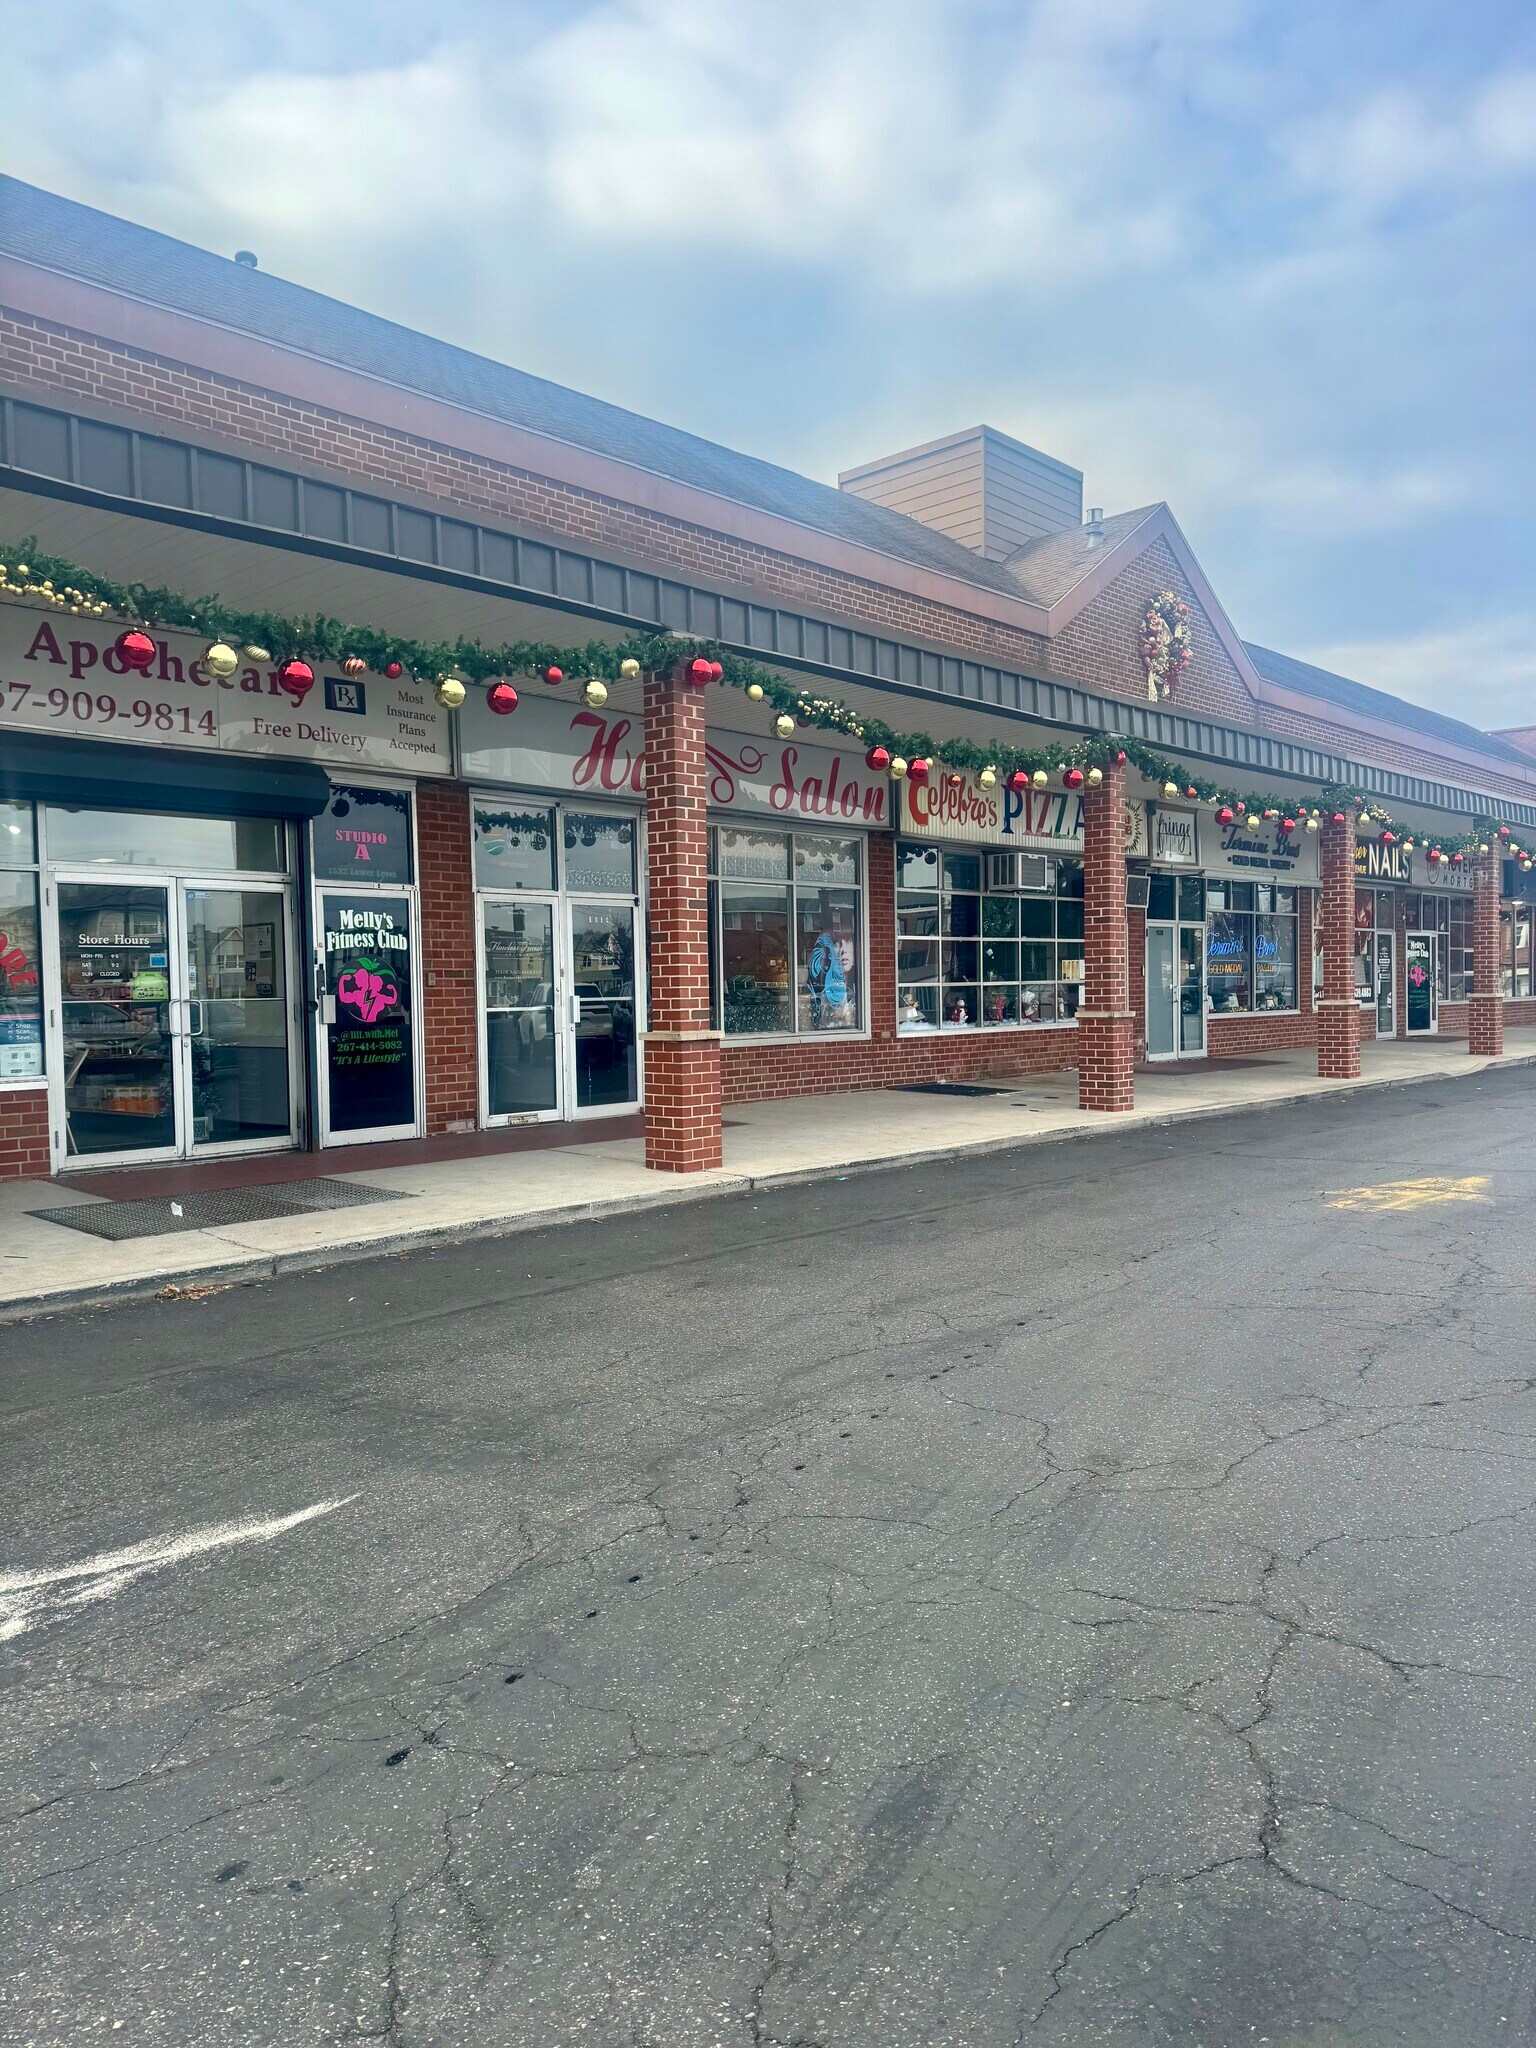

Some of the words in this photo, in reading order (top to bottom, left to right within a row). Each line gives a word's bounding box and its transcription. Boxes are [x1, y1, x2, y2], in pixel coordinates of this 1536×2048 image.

[398, 690, 424, 705] Most
[0, 680, 217, 737] 7-909-9814
[386, 705, 437, 723] Insurance
[253, 717, 292, 738] Free
[297, 723, 366, 752] Delivery
[398, 723, 426, 737] Plans
[389, 738, 436, 754] Accepted
[769, 746, 887, 822] Salon
[335, 829, 387, 845] STUDIO
[1156, 812, 1191, 854] fringe
[1221, 823, 1269, 854] Termini
[354, 843, 371, 860] A
[1368, 843, 1410, 879] NAILS
[1443, 876, 1474, 888] MORTG
[339, 909, 394, 930] Melly's
[79, 934, 110, 945] Store
[114, 934, 150, 945] Hours
[326, 931, 375, 952] Fitness
[377, 929, 408, 951] Club
